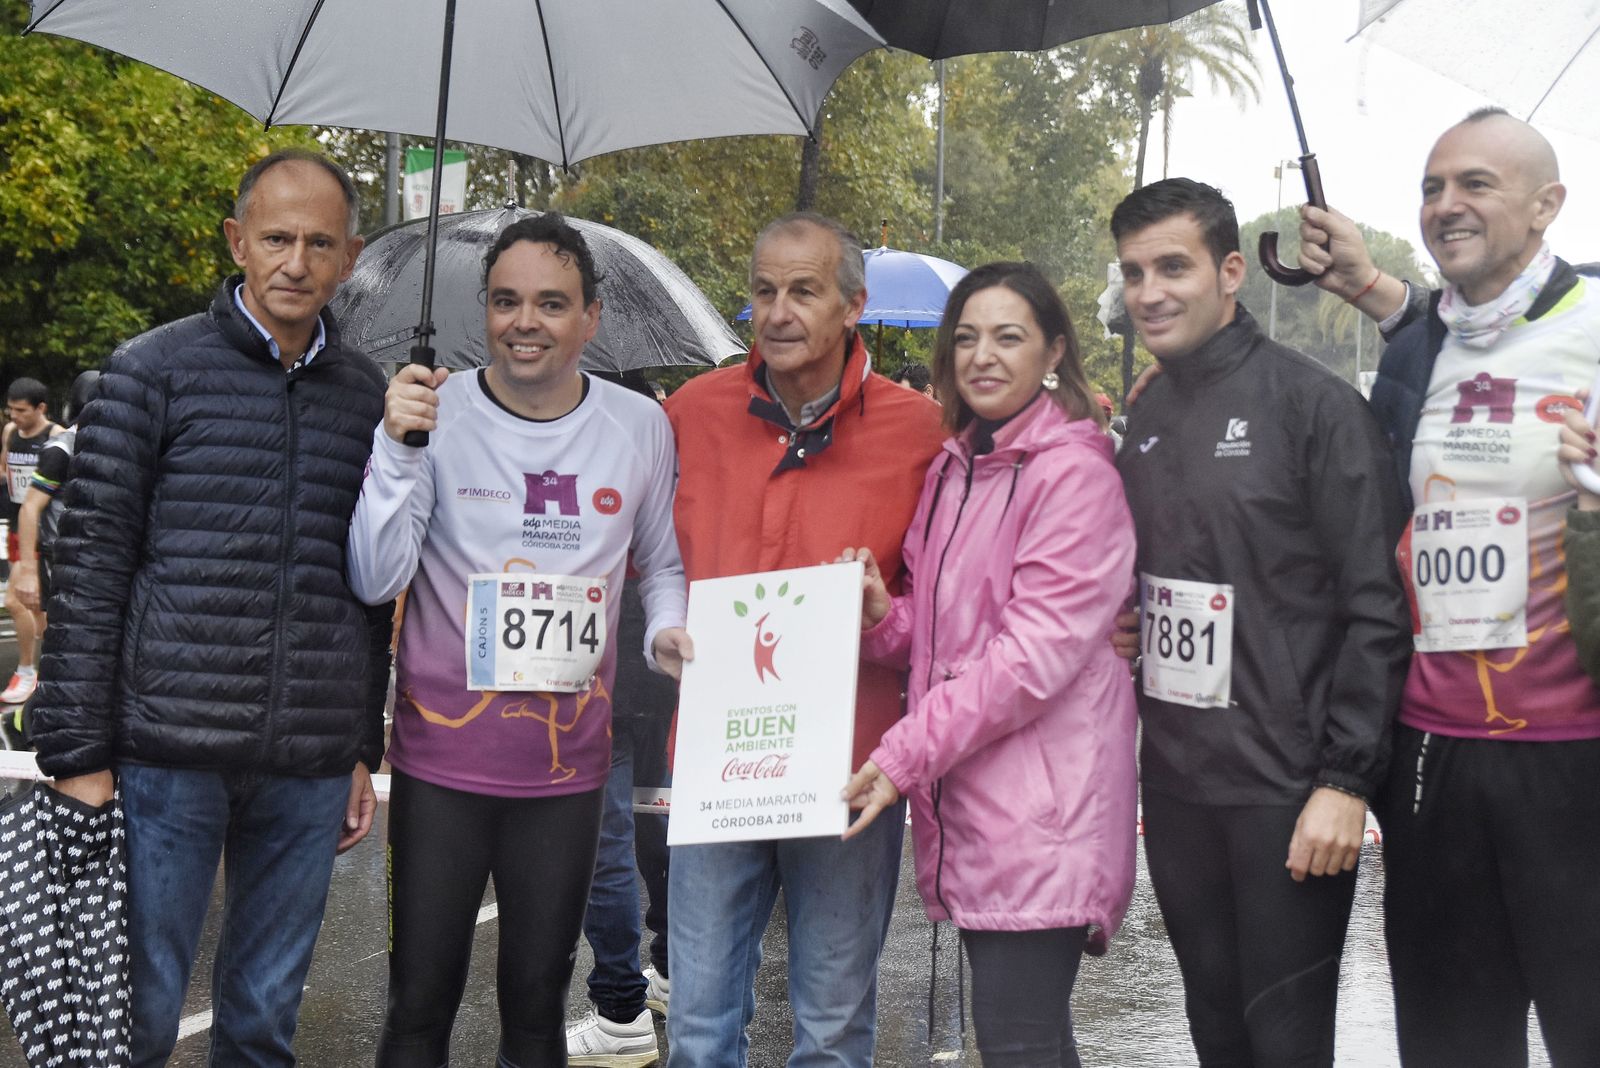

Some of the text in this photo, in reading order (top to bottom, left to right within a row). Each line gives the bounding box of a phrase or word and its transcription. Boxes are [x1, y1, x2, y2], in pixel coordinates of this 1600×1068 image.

[1474, 381, 1491, 392] 34
[1466, 429, 1511, 439] MEDIA
[1443, 440, 1510, 454] MARATÓN
[542, 477, 558, 487] 34
[469, 487, 511, 500] IMDECO
[600, 495, 615, 507] edp
[523, 517, 581, 530] edp MEDIA
[522, 530, 581, 542] MARATÓN
[522, 540, 561, 550] CÓRDOBA
[1417, 543, 1505, 587] 0000
[502, 607, 599, 654] 8714
[1146, 611, 1215, 666] 7881
[727, 703, 797, 718] EVENTOS CON
[726, 714, 796, 740] BUEN
[725, 737, 794, 753] AMBIENTE
[700, 792, 817, 812] 34 MEDIA MARATÓN
[712, 812, 803, 829] CÓRDOBA 2018
